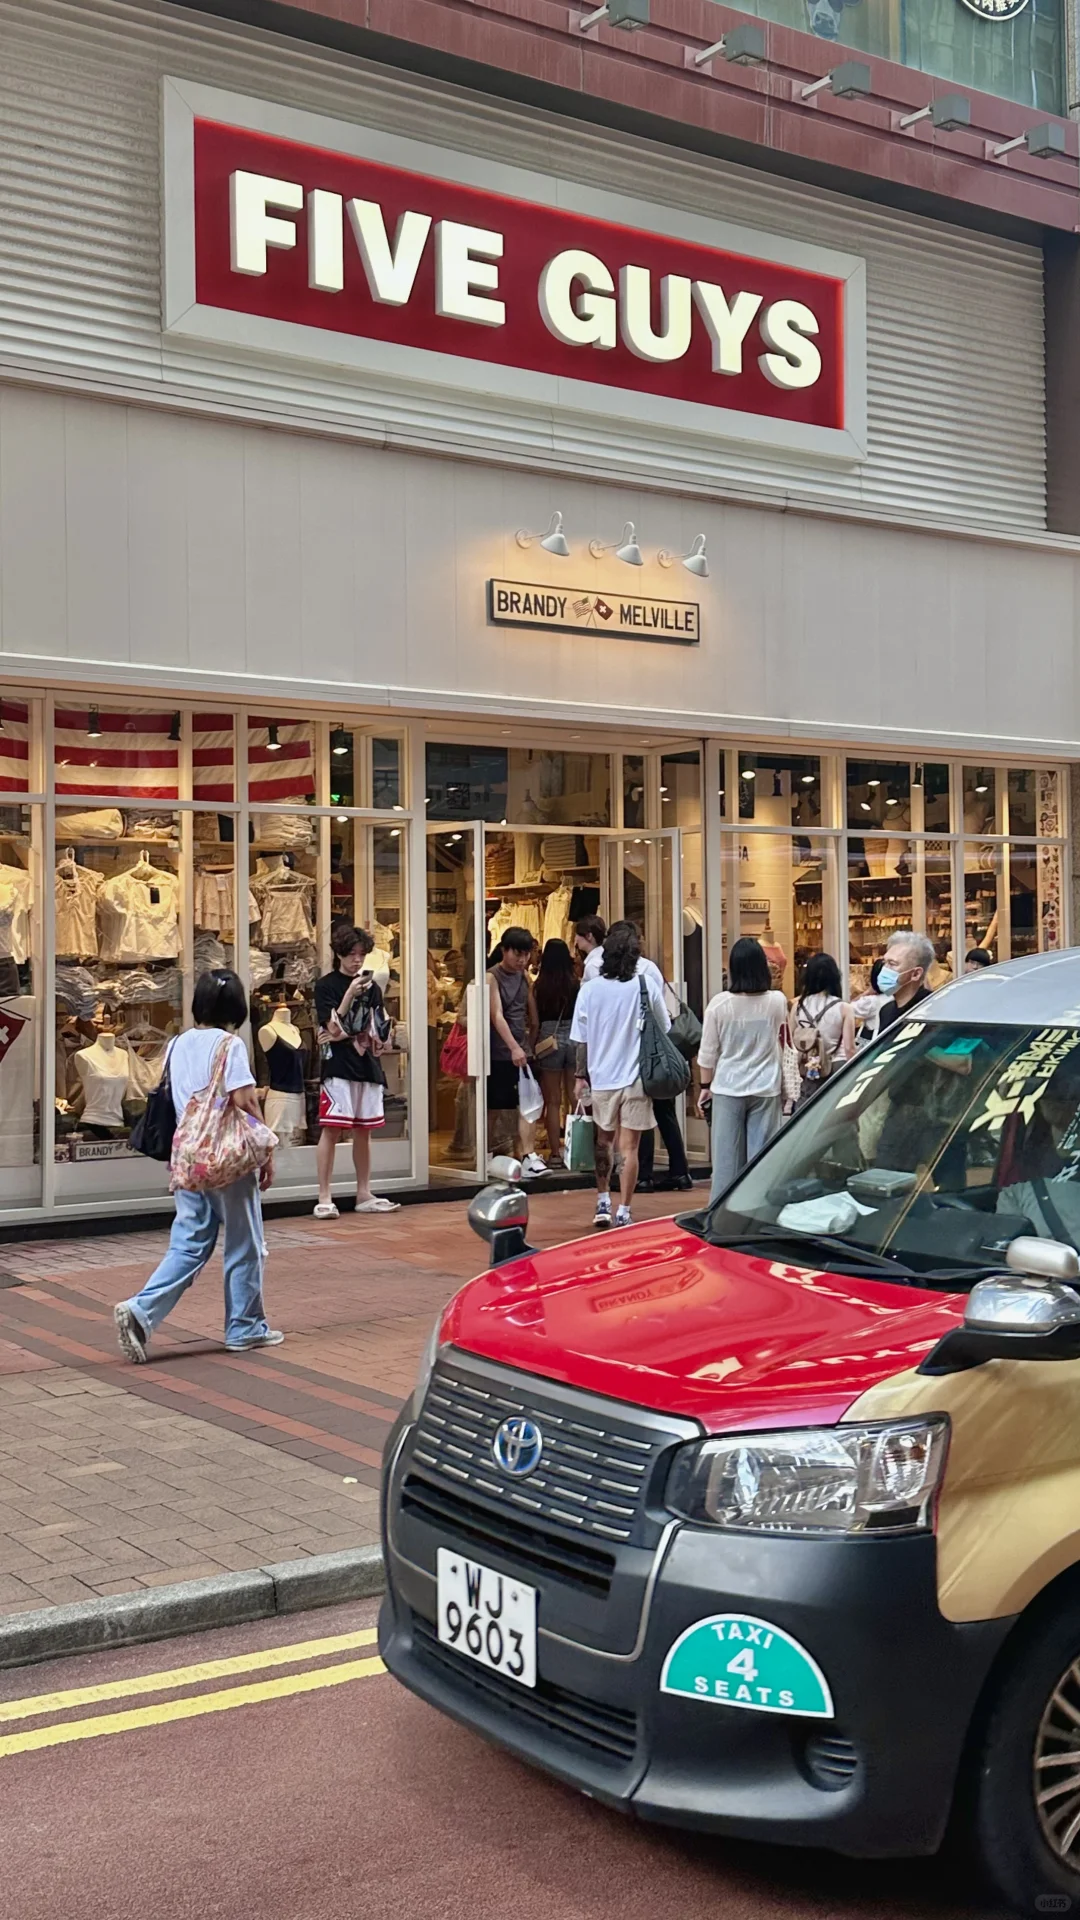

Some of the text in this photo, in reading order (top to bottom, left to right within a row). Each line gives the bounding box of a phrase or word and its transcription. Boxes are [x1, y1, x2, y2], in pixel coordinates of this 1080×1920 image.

[229, 169, 823, 390] FIVE GUYS
[497, 589, 695, 632] BRANDY MELVILLE
[79, 1146, 114, 1157] BRANDY
[465, 1562, 503, 1619] WJ
[446, 1601, 524, 1677] 9603
[711, 1622, 775, 1650] TAXI
[726, 1648, 759, 1683] 4
[694, 1676, 795, 1708] SEATS
